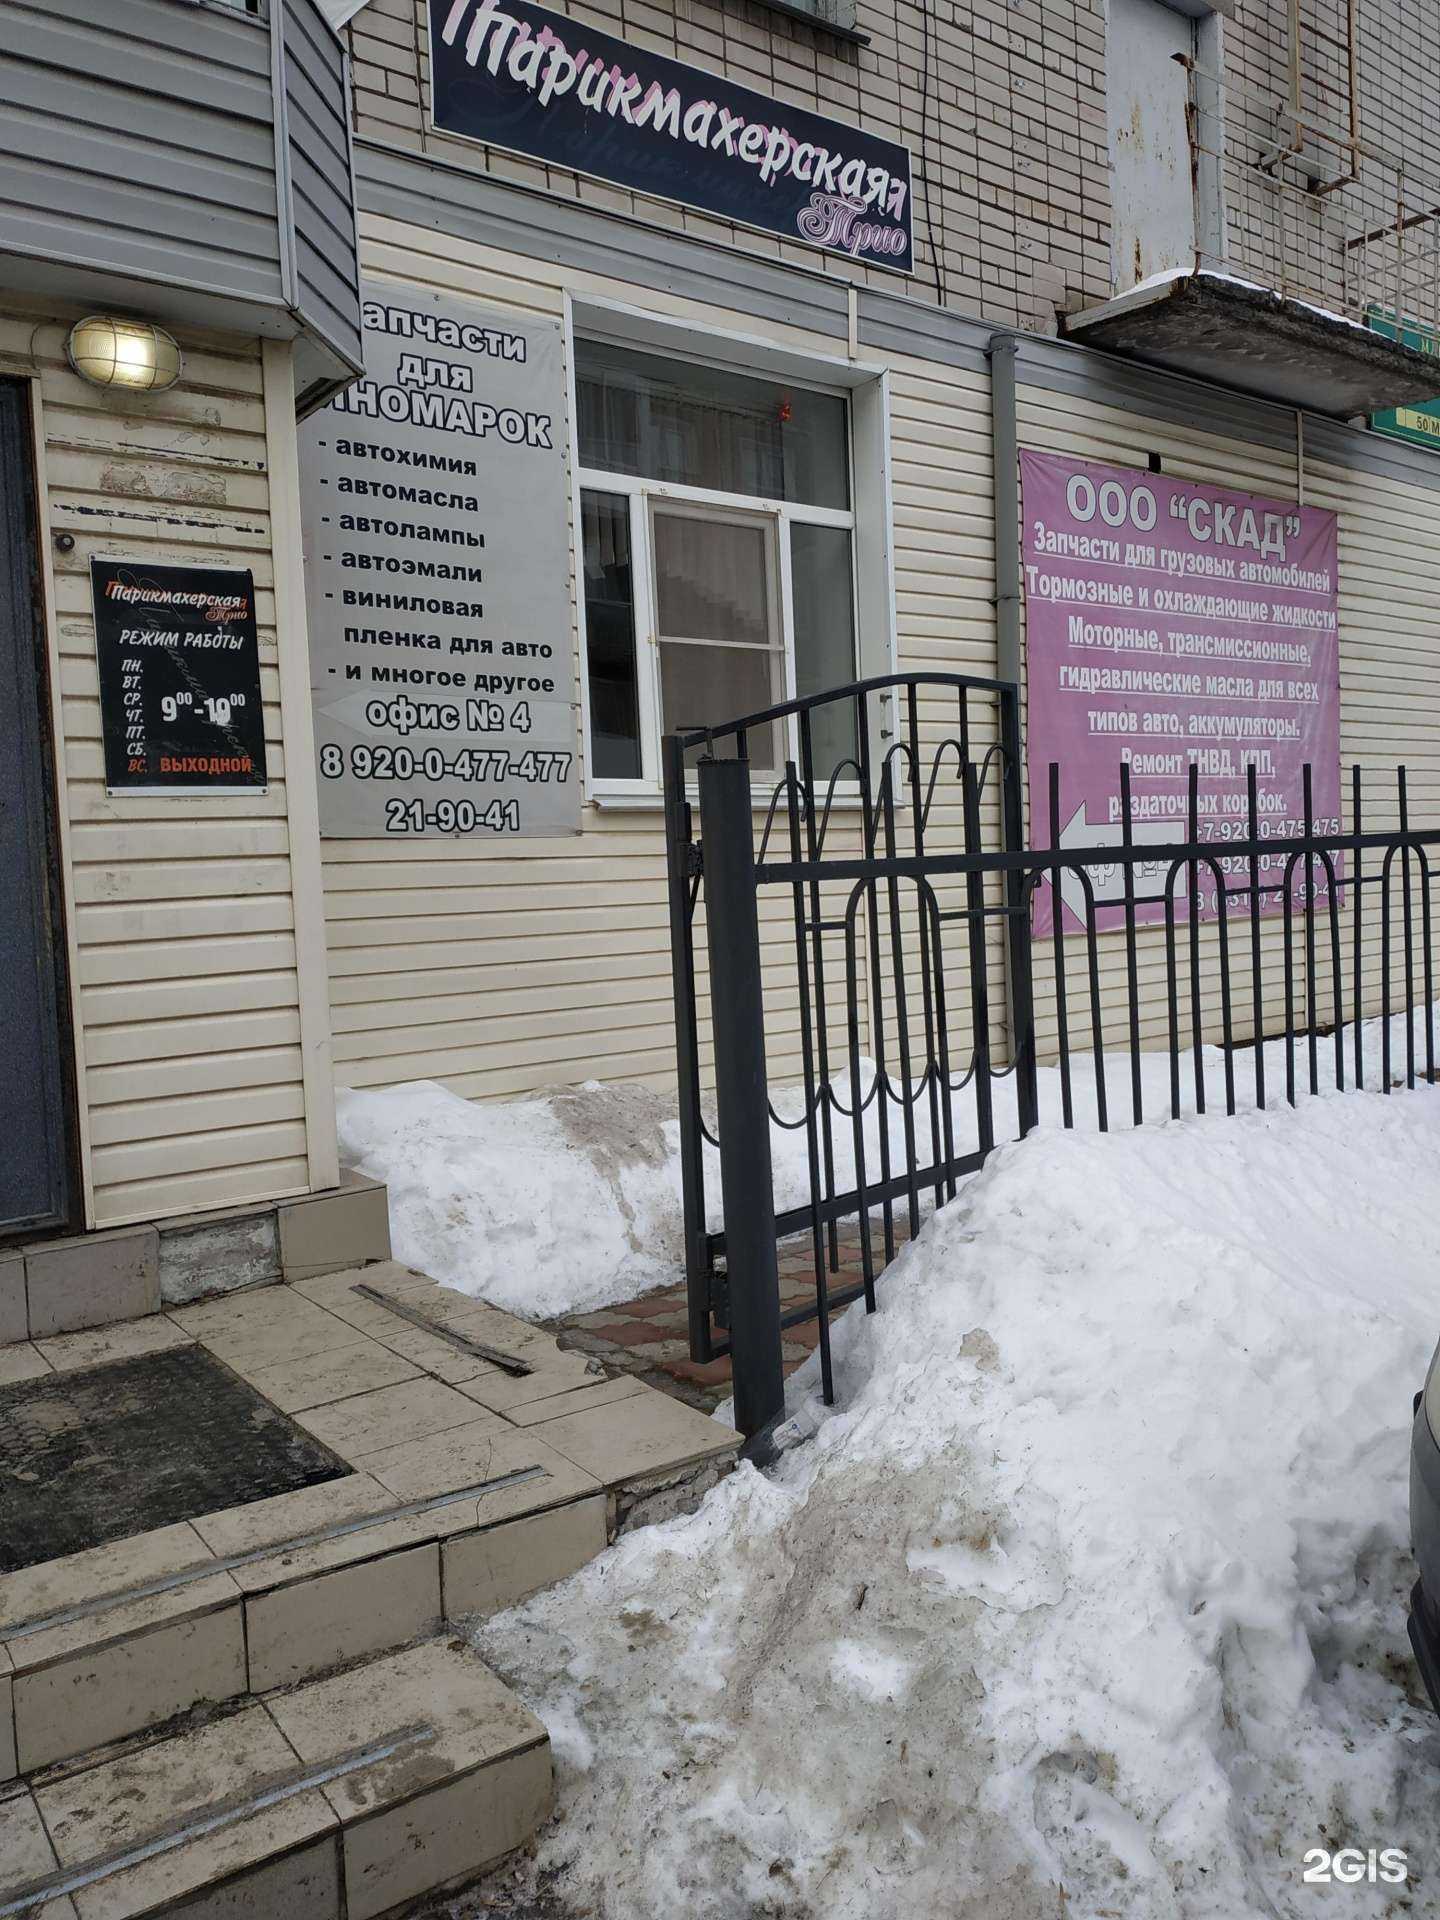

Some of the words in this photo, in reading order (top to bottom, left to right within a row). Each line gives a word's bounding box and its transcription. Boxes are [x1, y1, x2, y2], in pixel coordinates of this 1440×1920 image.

[444, 0, 907, 221] Парикмахерская
[797, 192, 907, 256] Трио
[363, 301, 526, 363] апчасти
[397, 353, 473, 393] для
[336, 439, 477, 476] автохимия
[338, 477, 479, 512] автомасла
[1066, 474, 1157, 532] ООО
[340, 515, 485, 547] автолампы
[341, 552, 482, 583] автоэмали
[1034, 521, 1120, 561] Запчасти
[1124, 547, 1155, 567] для
[1160, 548, 1235, 578] грузовых
[1240, 561, 1330, 592] автомобилей
[105, 581, 248, 609] Парикмахерская
[343, 590, 483, 618] виниловая
[1026, 565, 1133, 606] Тормозные
[1138, 587, 1149, 606] и
[1154, 589, 1268, 622] охлаждающие
[1272, 606, 1336, 629] жидкости
[119, 630, 179, 647] РЕЖИМ
[184, 631, 244, 650] РАБОТЫ
[344, 627, 442, 650] пленка
[450, 636, 493, 655] для
[501, 640, 553, 658] авто
[1068, 616, 1163, 653] Моторные,
[121, 659, 144, 673] ПН.
[345, 665, 361, 680] и
[371, 666, 466, 687] многое
[474, 672, 555, 694] другое
[122, 676, 142, 690] ВТ.
[1059, 665, 1200, 695] гидравлические
[1206, 675, 1254, 697] масла
[1257, 679, 1283, 700] для
[1288, 682, 1318, 700] всех
[123, 693, 143, 707] СР.
[125, 709, 144, 723] ЧТ.
[366, 695, 460, 735] офис
[466, 699, 504, 731] №
[510, 702, 531, 733] 4
[125, 726, 146, 740] ПТ.
[1088, 711, 1137, 732] типов
[1143, 709, 1184, 736] авто,
[127, 742, 147, 756] СБ.
[160, 755, 253, 775] ВЫХОДНОЙ
[320, 744, 344, 778] 8
[351, 745, 572, 782] 920-0-477-477
[1121, 747, 1183, 774] Ремонт
[386, 798, 520, 832] 21-90-41
[1109, 793, 1217, 822] рздаточых
[1222, 788, 1287, 817] корбок.
